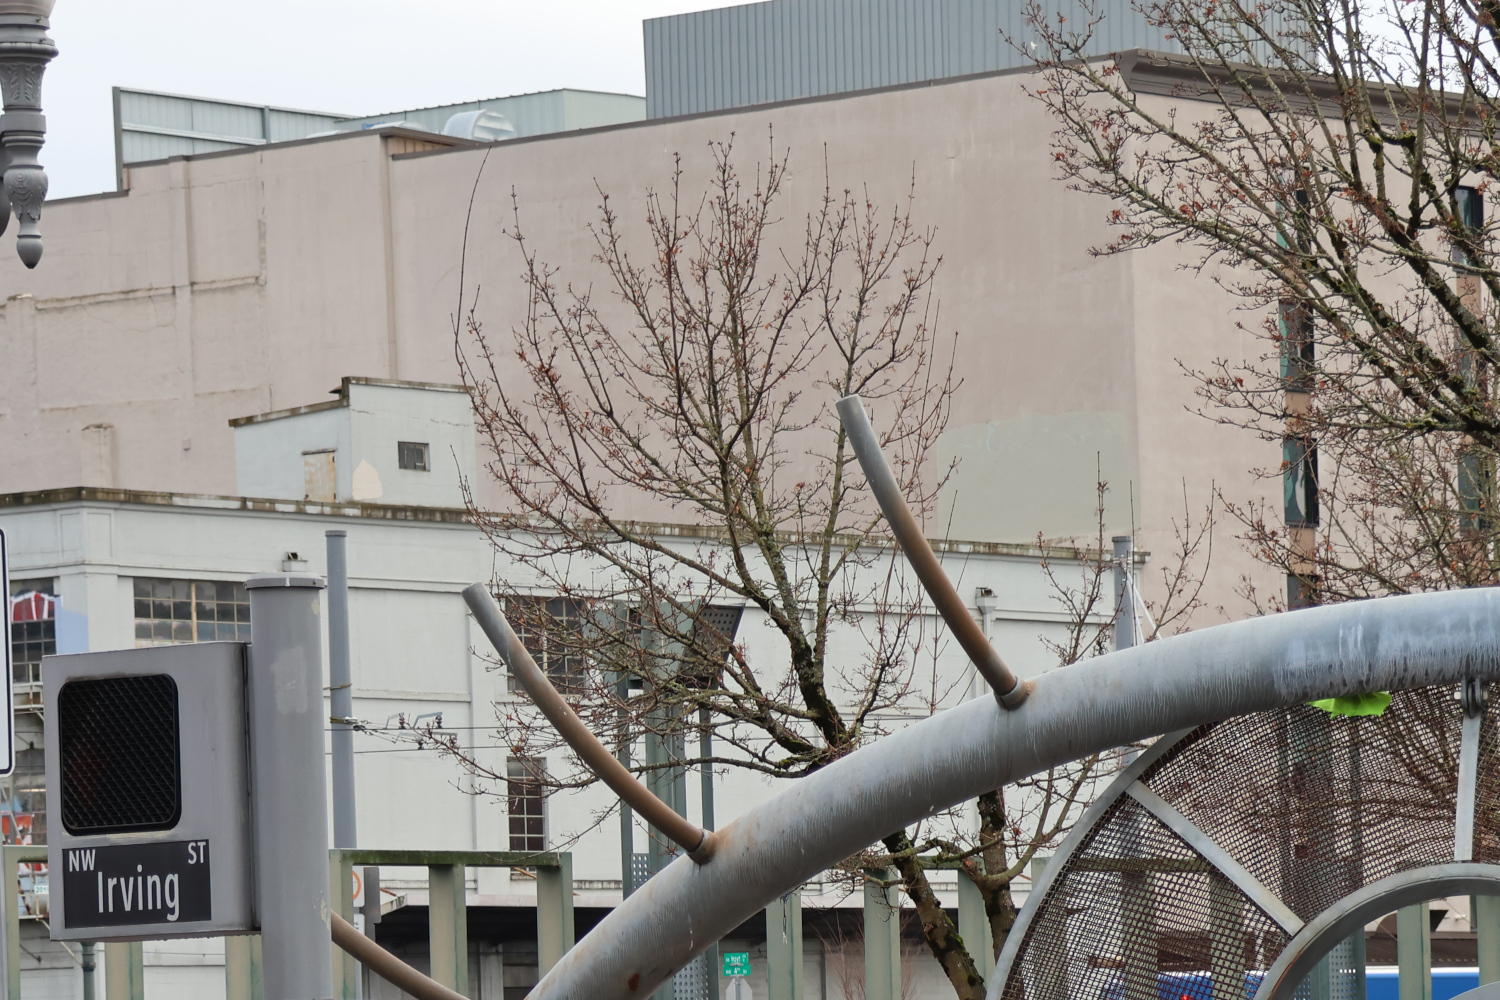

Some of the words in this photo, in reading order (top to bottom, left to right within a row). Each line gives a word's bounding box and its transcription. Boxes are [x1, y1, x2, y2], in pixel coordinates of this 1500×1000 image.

[68, 849, 96, 872] NW
[187, 841, 207, 865] ST
[97, 864, 180, 922] Irving
